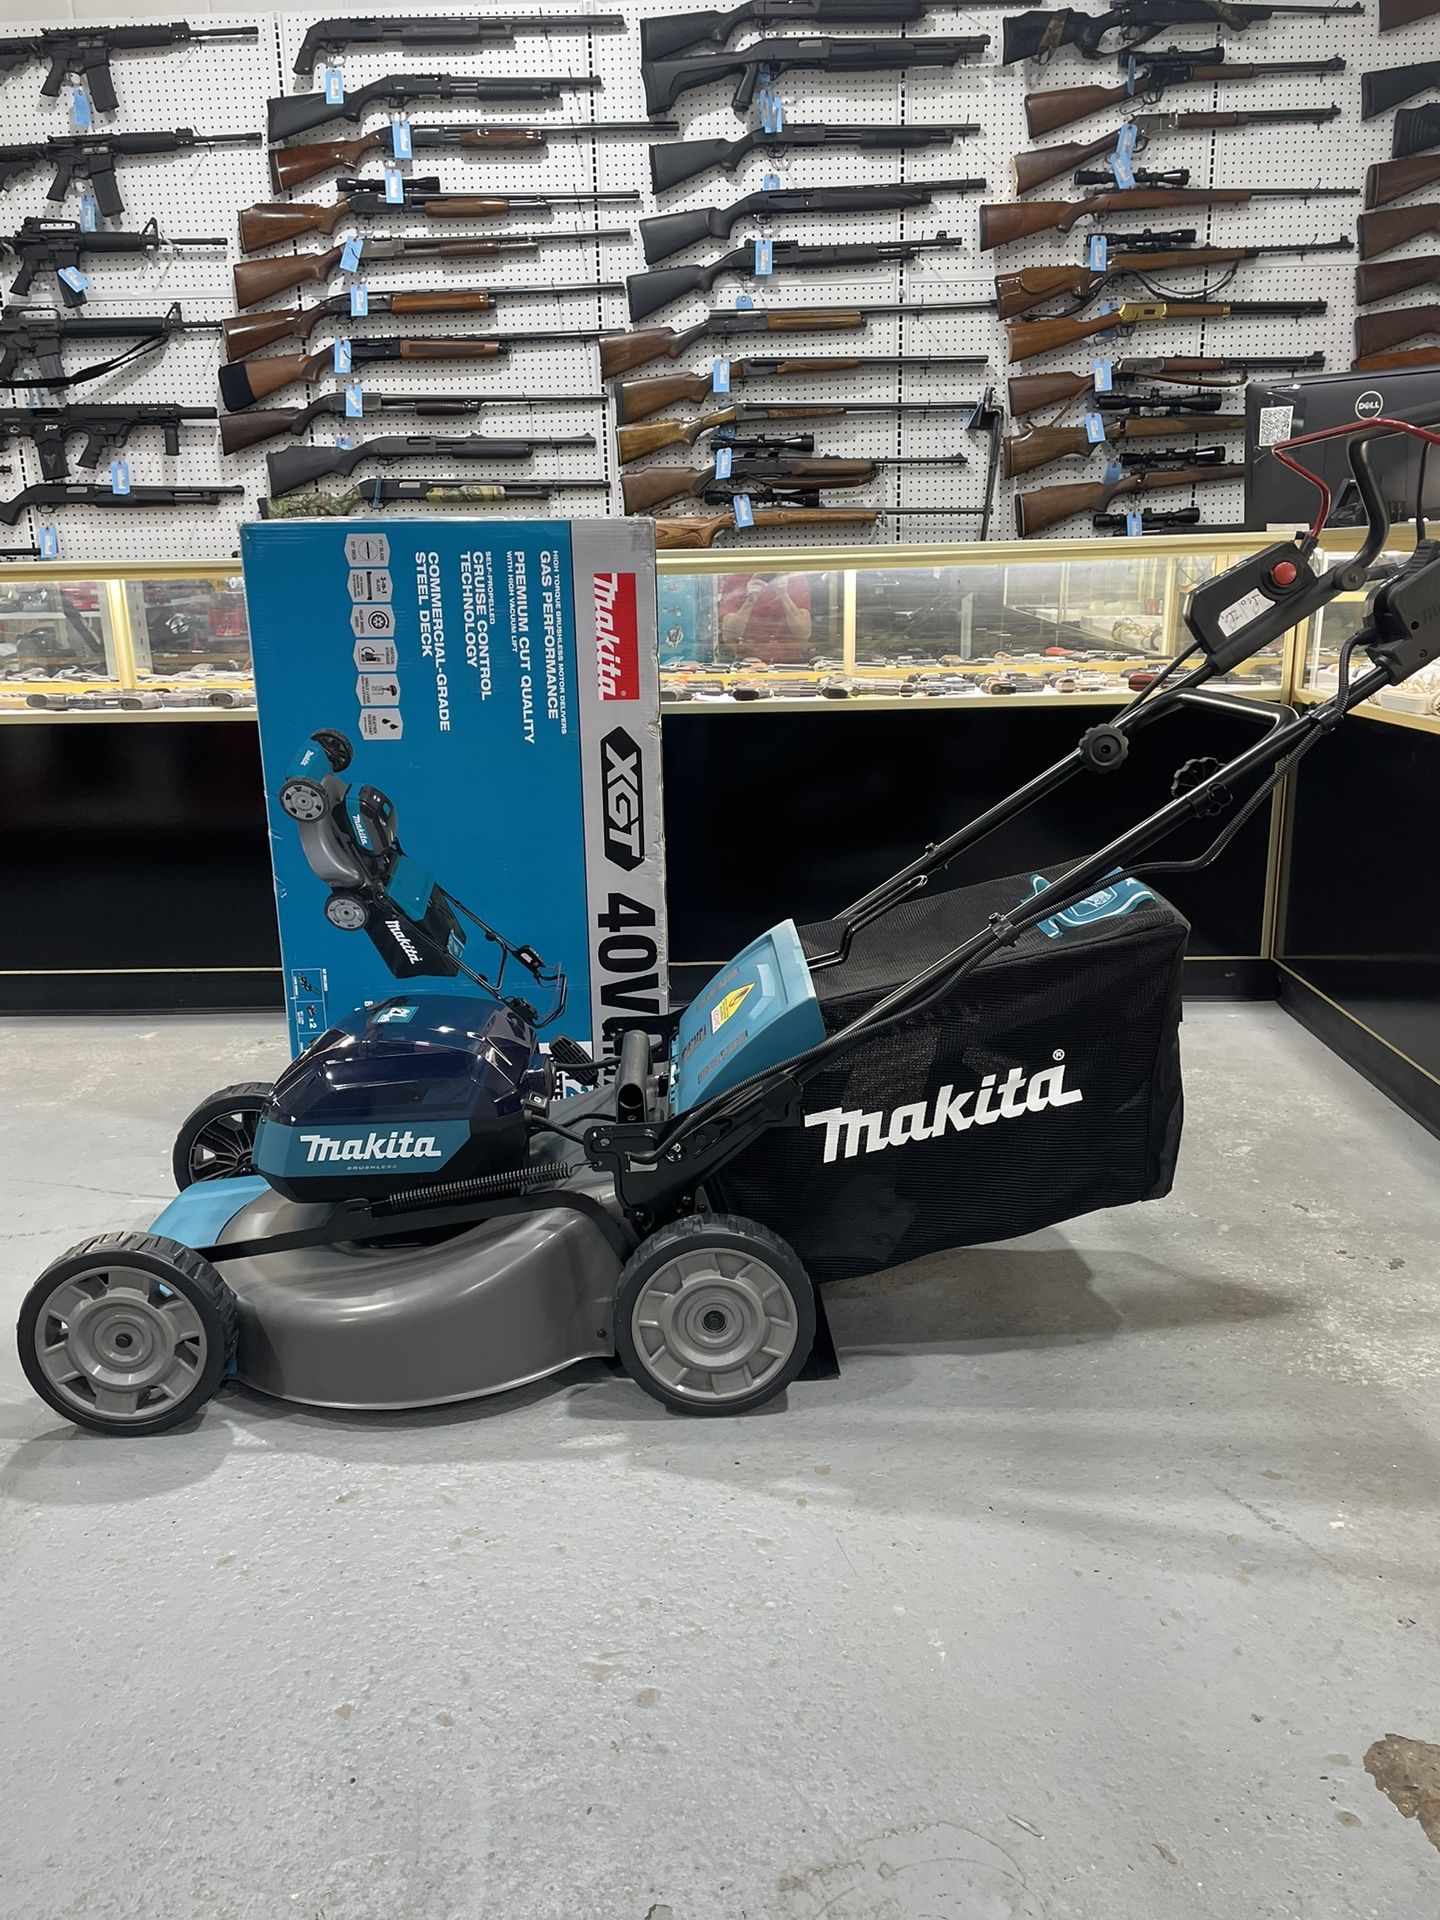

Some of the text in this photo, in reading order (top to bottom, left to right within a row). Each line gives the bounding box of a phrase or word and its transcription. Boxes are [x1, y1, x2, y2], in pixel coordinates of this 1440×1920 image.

[1358, 401, 1380, 410] DELL
[415, 552, 432, 657] STEEL DECK
[428, 552, 450, 731] COMMERCIAL-GRADE
[460, 551, 477, 667] TECHNOLOGY
[473, 551, 492, 700] CRUISE CONTROL
[486, 551, 495, 624] SELF-PROPELLED
[540, 551, 558, 719] GAS PERFORMANCE
[554, 575, 562, 608] TORQUE
[556, 612, 564, 661] BRUSHLESS
[515, 551, 534, 744] PREMIUM CUT QUALITY
[605, 742, 640, 858] XGT
[598, 893, 659, 1014] 40V
